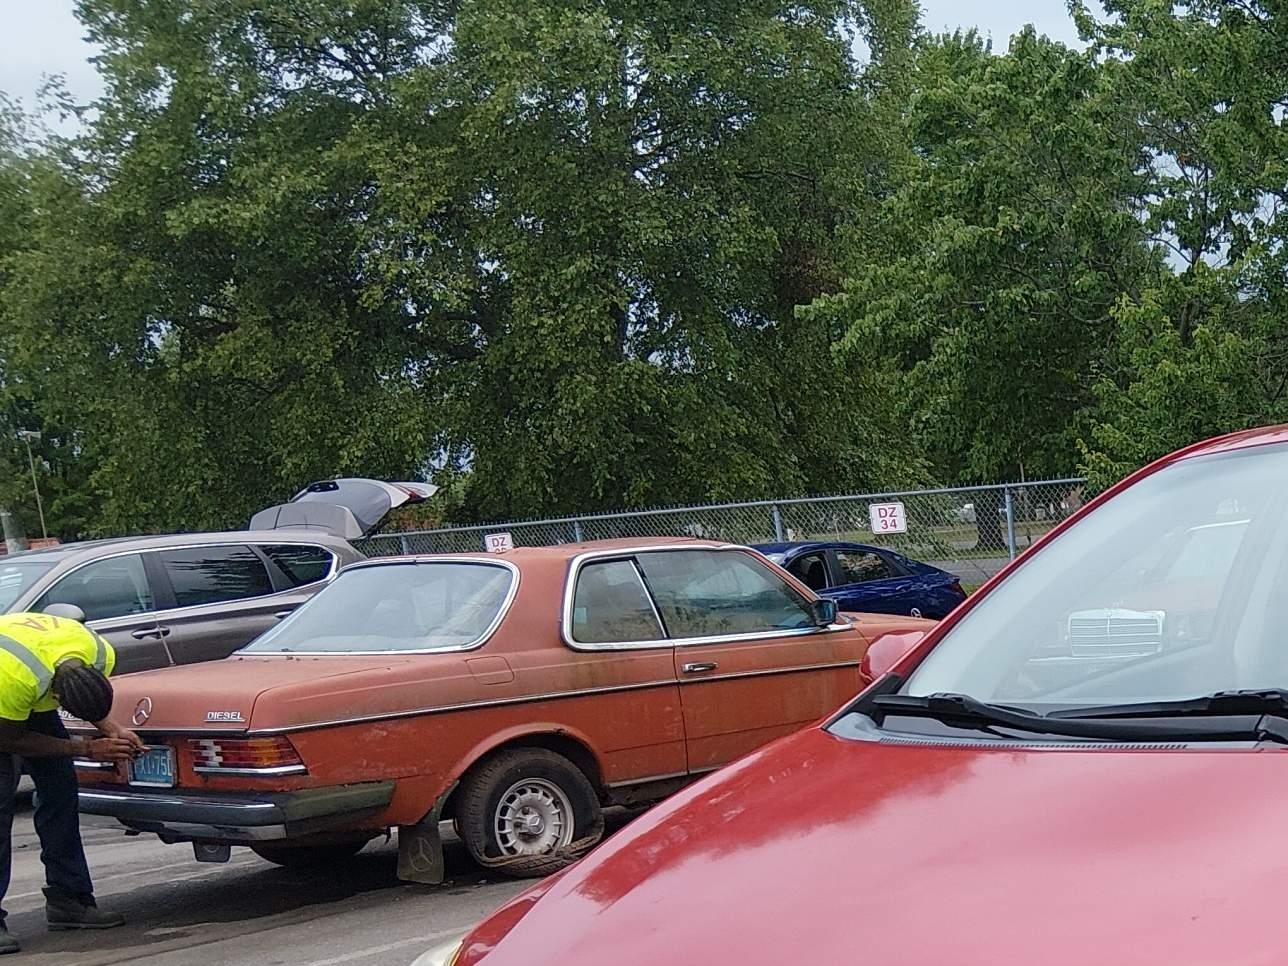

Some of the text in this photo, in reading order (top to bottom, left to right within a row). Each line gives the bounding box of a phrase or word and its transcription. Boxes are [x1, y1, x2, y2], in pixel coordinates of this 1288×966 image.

[877, 506, 898, 519] DZ
[880, 518, 898, 530] 34
[491, 536, 508, 548] DZ
[206, 711, 243, 721] DIESEL
